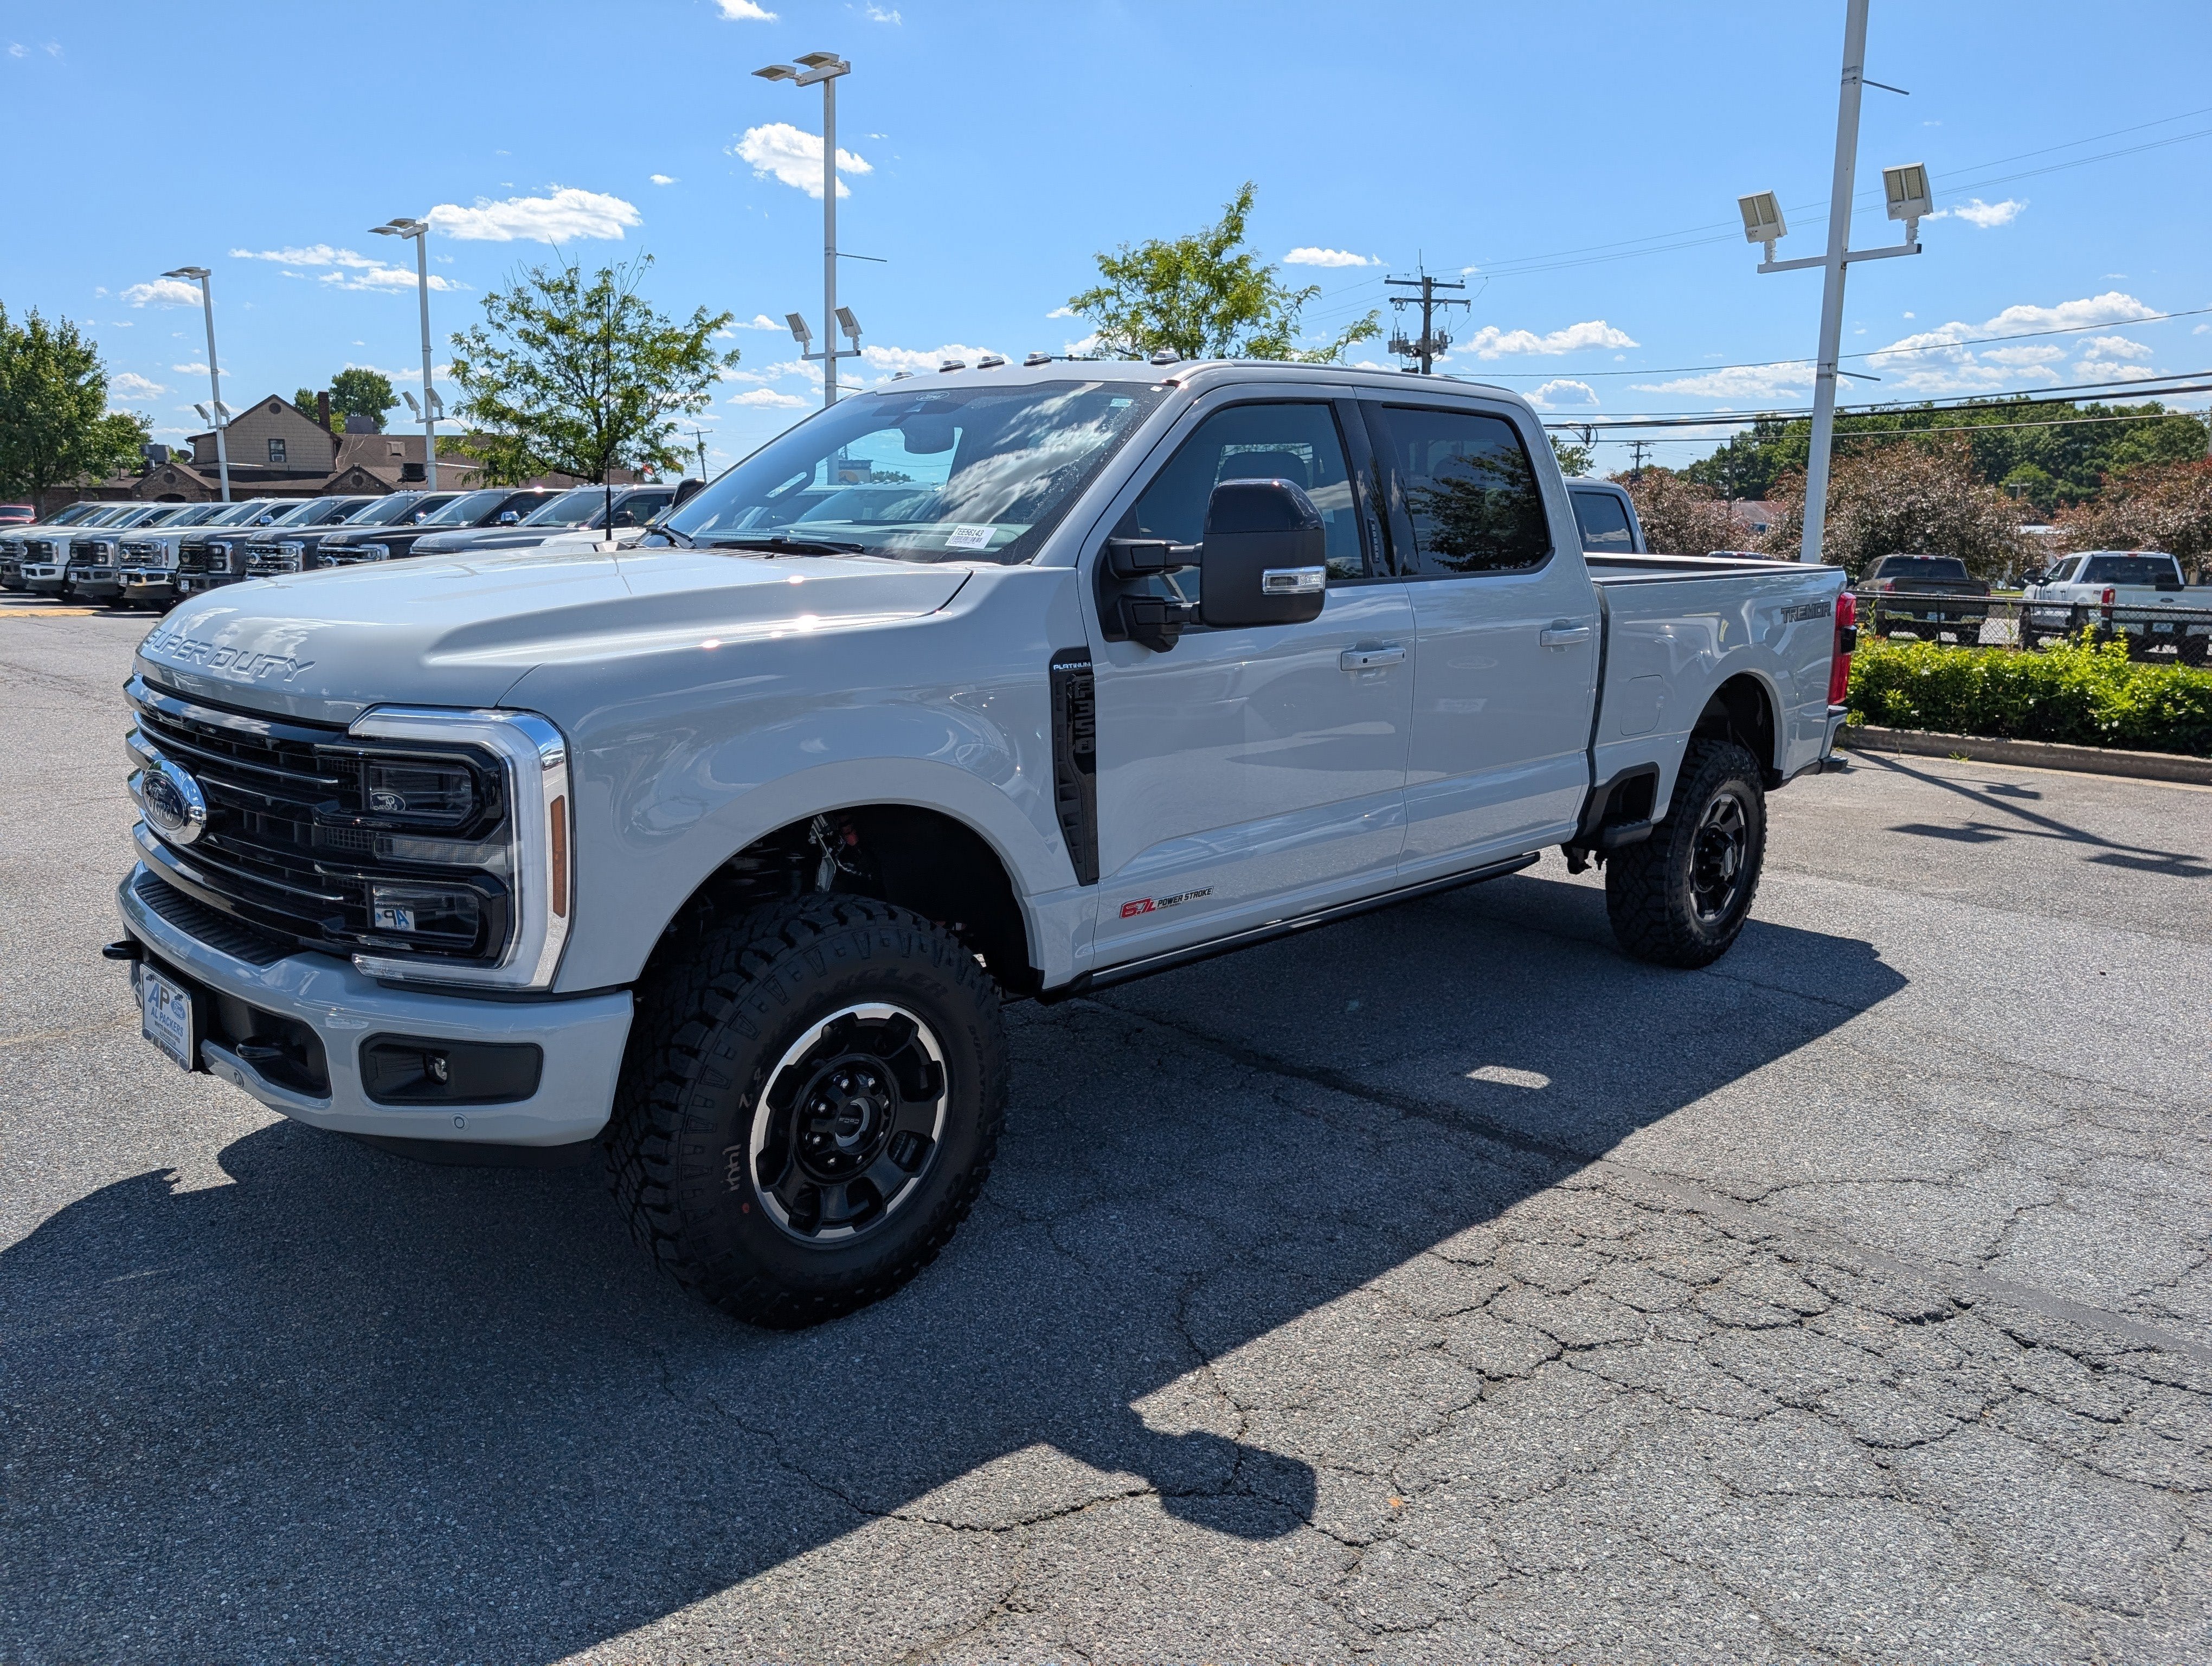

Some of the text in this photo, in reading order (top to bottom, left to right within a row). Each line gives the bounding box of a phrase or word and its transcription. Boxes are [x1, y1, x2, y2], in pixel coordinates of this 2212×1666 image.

[955, 528, 985, 536] TEE56143
[1781, 601, 1831, 623] TREMOR
[143, 629, 317, 682] SUPER DUTY
[1053, 661, 1091, 670] PLATINUM
[148, 782, 173, 822] Ford
[1121, 888, 1212, 918] 6.7L POWER STROKE
[148, 983, 170, 1011] AP
[151, 1007, 184, 1037] AL PACKERS
